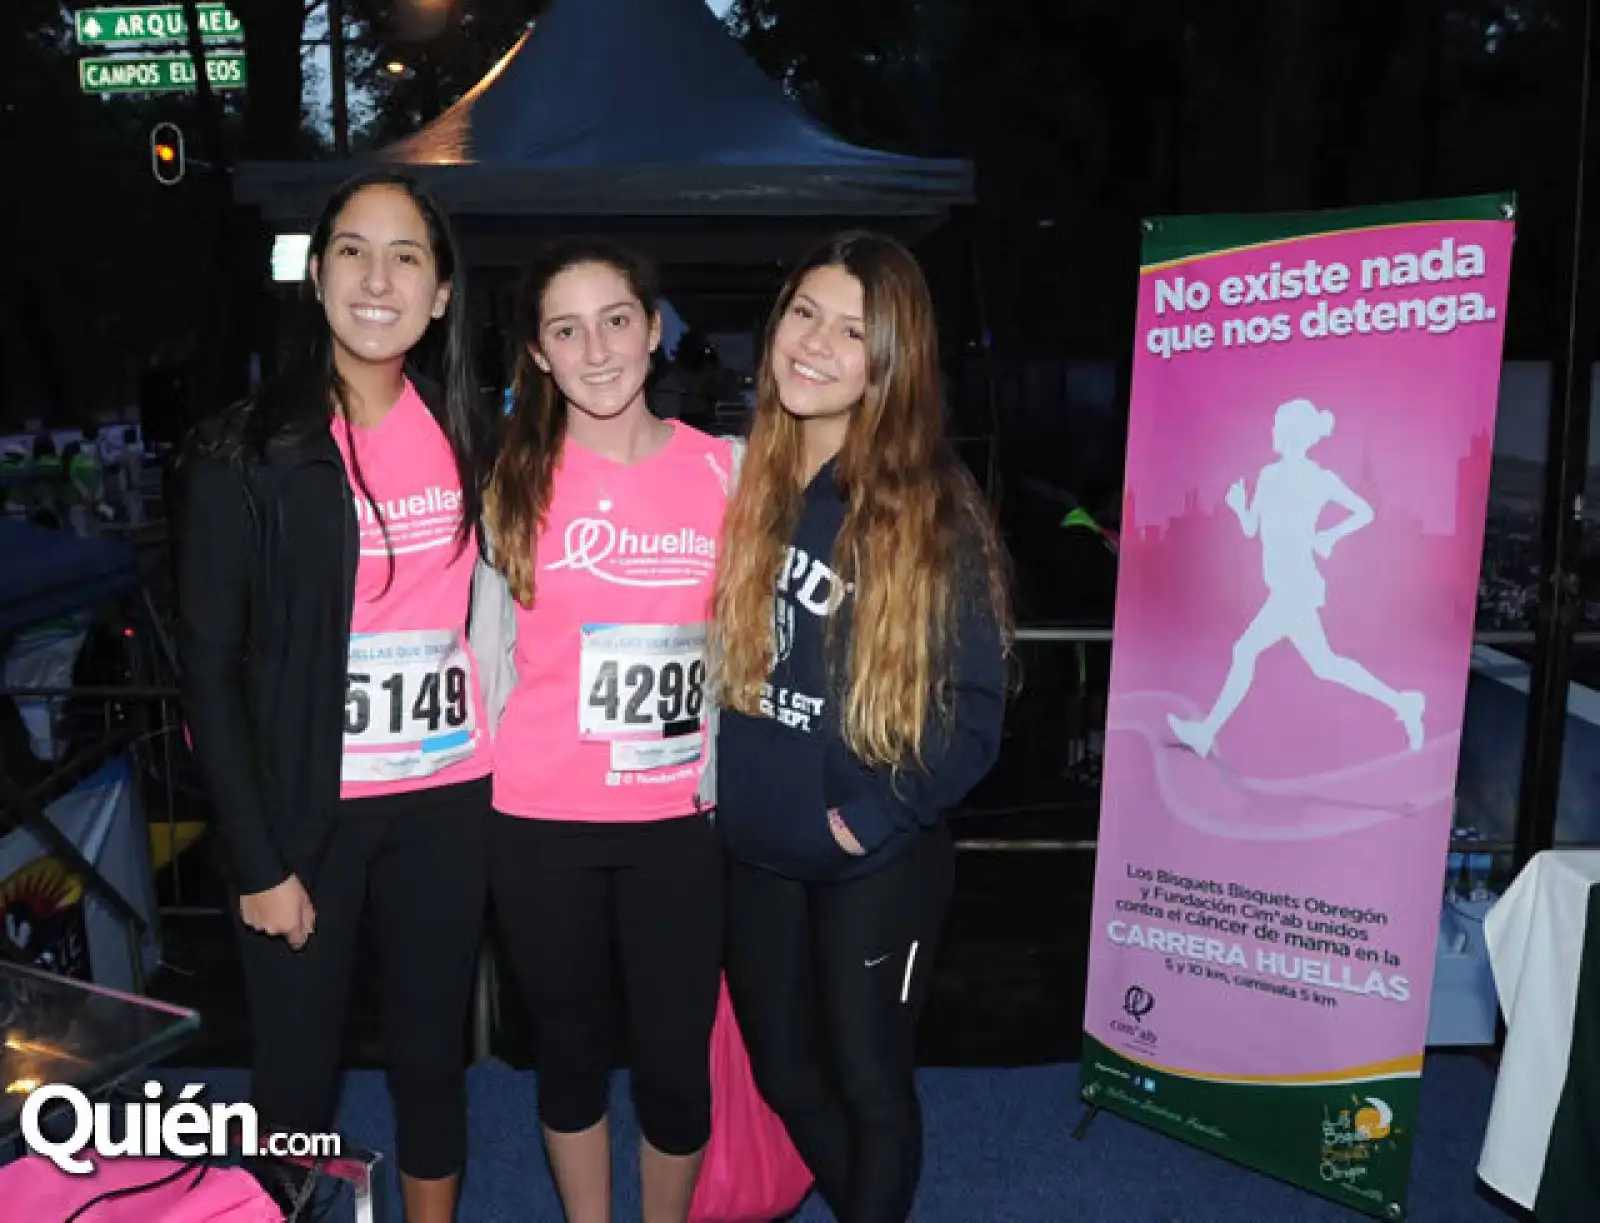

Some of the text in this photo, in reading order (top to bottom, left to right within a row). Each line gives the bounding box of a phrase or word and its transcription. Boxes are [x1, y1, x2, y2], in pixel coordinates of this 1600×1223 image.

[86, 64, 161, 86] CAMPOS
[1154, 237, 1486, 314] No existe nada
[1147, 291, 1496, 359] que nos detenga.
[364, 486, 463, 524] huella
[344, 667, 467, 733] 5149
[589, 660, 706, 723] 4298
[1127, 863, 1388, 925] Los Bisquets Bisquets Obregón
[1140, 886, 1151, 900] y
[1154, 886, 1236, 917] Fundación
[1307, 919, 1369, 942] unidos
[1107, 919, 1411, 1003] CARRERA HUELLAS
[1115, 900, 1400, 967] contra el cáncer de mama en la
[1312, 989, 1338, 1008] km
